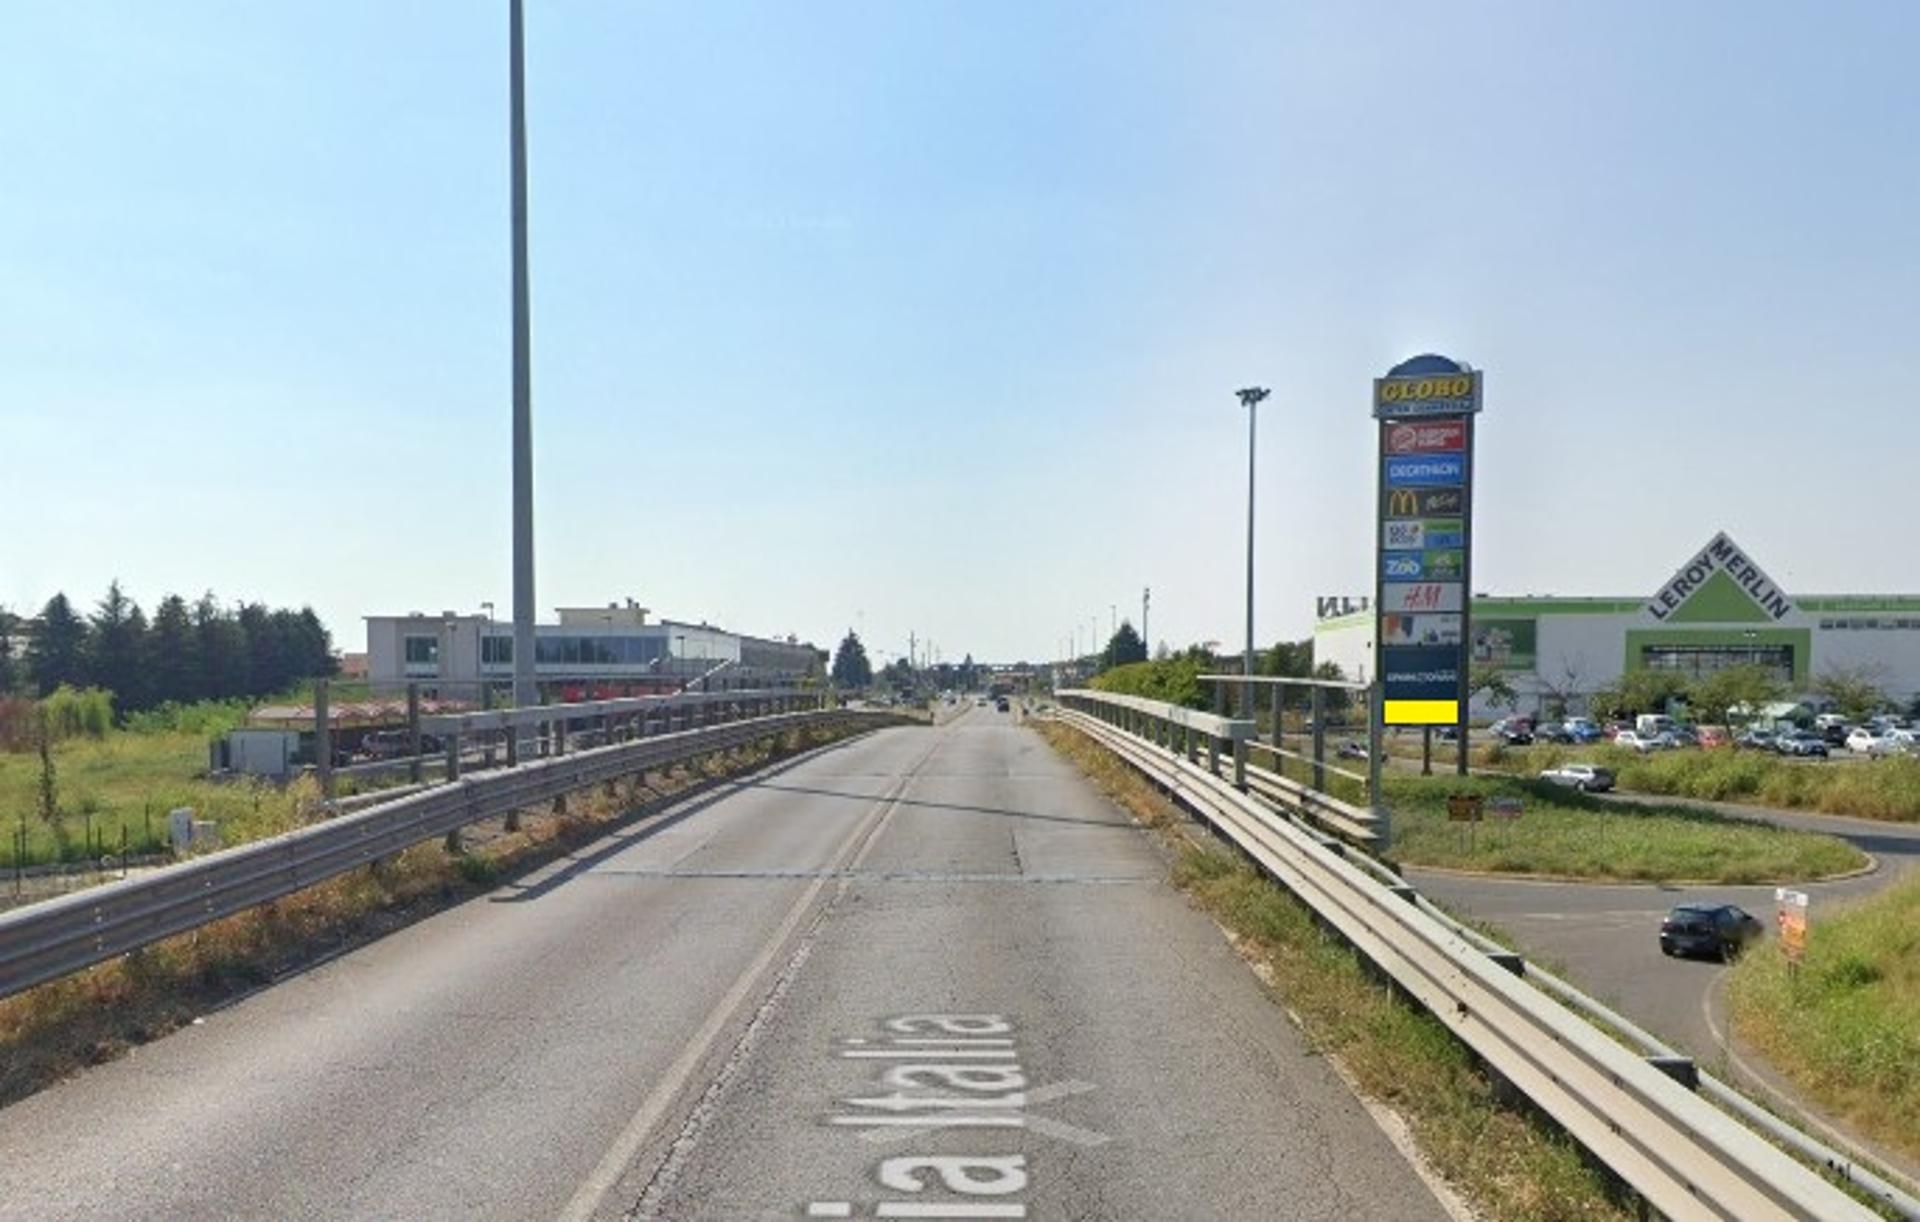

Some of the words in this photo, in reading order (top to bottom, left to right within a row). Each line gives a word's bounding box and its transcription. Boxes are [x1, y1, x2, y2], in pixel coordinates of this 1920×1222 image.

[1382, 379, 1469, 401] GLOBO
[1389, 463, 1459, 477] DECATHLON
[1648, 553, 1715, 619] LEROY
[1709, 539, 1791, 620] MERLIN
